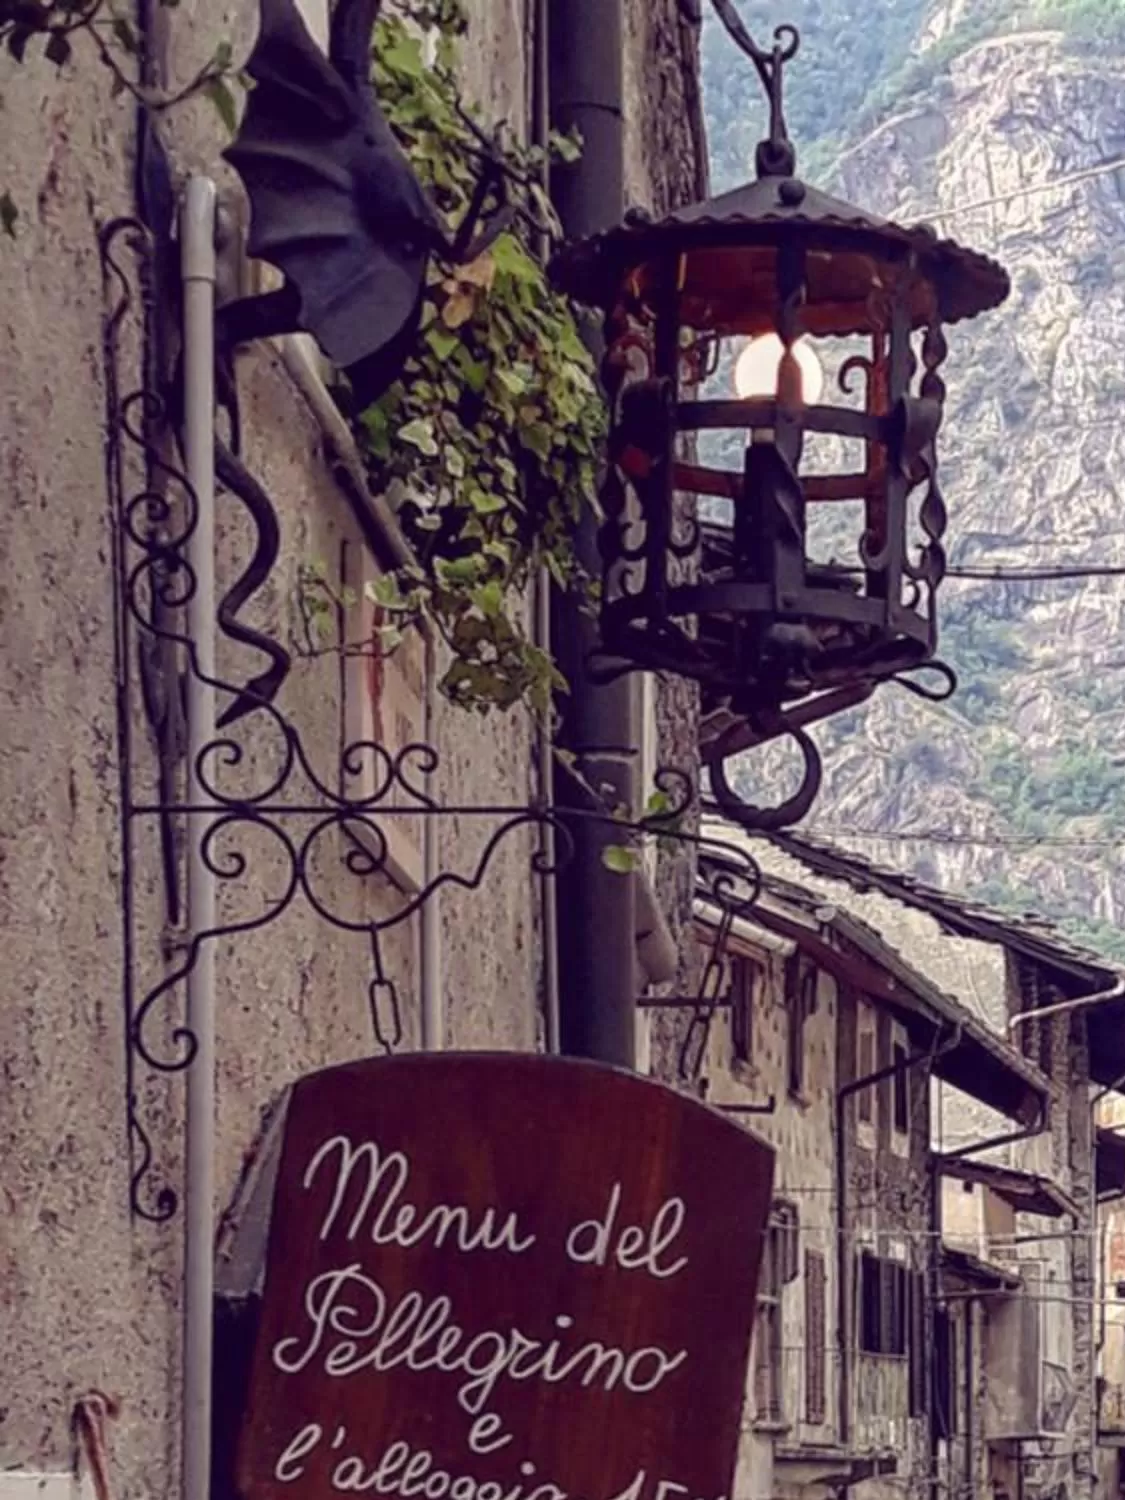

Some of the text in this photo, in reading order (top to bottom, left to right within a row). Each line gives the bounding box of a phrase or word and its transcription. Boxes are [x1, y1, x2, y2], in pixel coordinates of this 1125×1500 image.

[303, 1134, 688, 1279] Menu del
[272, 1262, 688, 1415] Pellegrino
[467, 1411, 513, 1454] e
